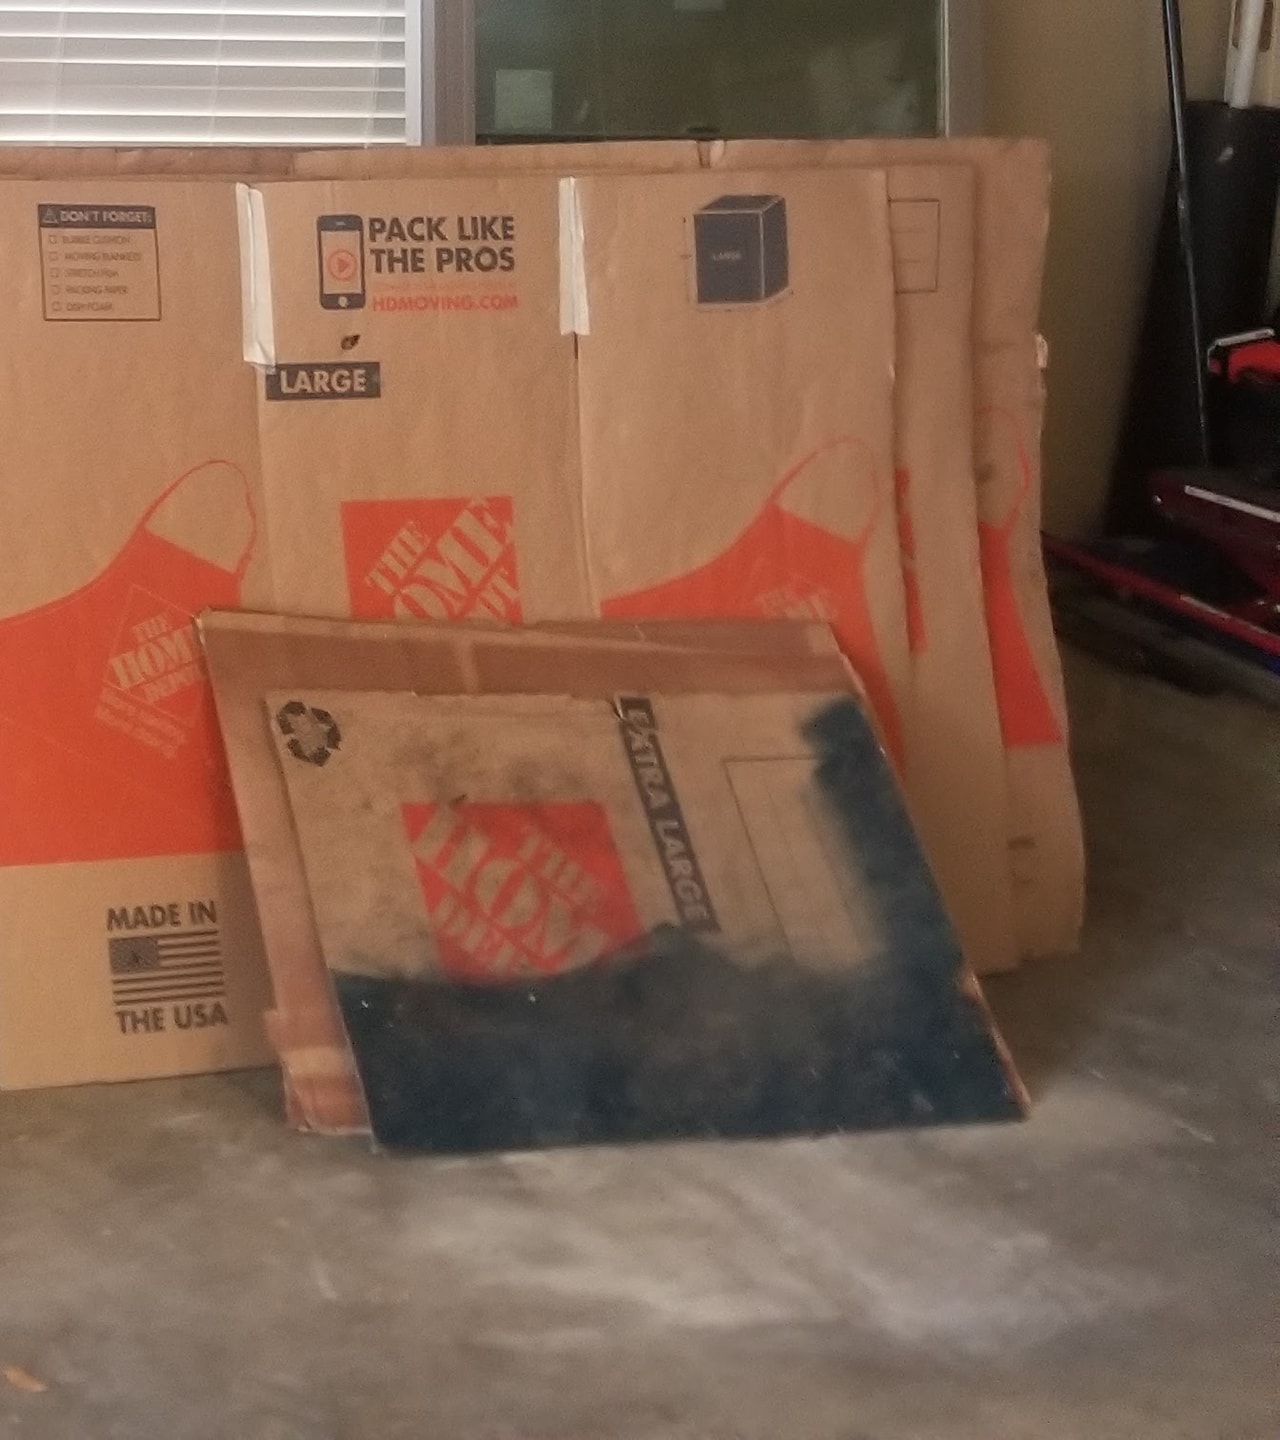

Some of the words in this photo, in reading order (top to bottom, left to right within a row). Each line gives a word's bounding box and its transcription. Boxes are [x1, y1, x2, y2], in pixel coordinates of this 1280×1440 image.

[368, 216, 449, 242] PACK
[457, 215, 515, 241] LIKE
[368, 247, 426, 274] THE
[436, 246, 516, 273] PROS
[372, 294, 519, 311] HDMOVING.COM
[280, 369, 367, 394] LARGE
[393, 495, 512, 620] OME
[107, 623, 200, 690] HOM
[626, 709, 672, 809] EXTRA
[656, 817, 711, 922] LARGE
[411, 805, 610, 973] HOM
[106, 903, 182, 931] MADE
[188, 900, 218, 926] IN
[115, 1006, 166, 1035] THE
[173, 1001, 230, 1029] USA
